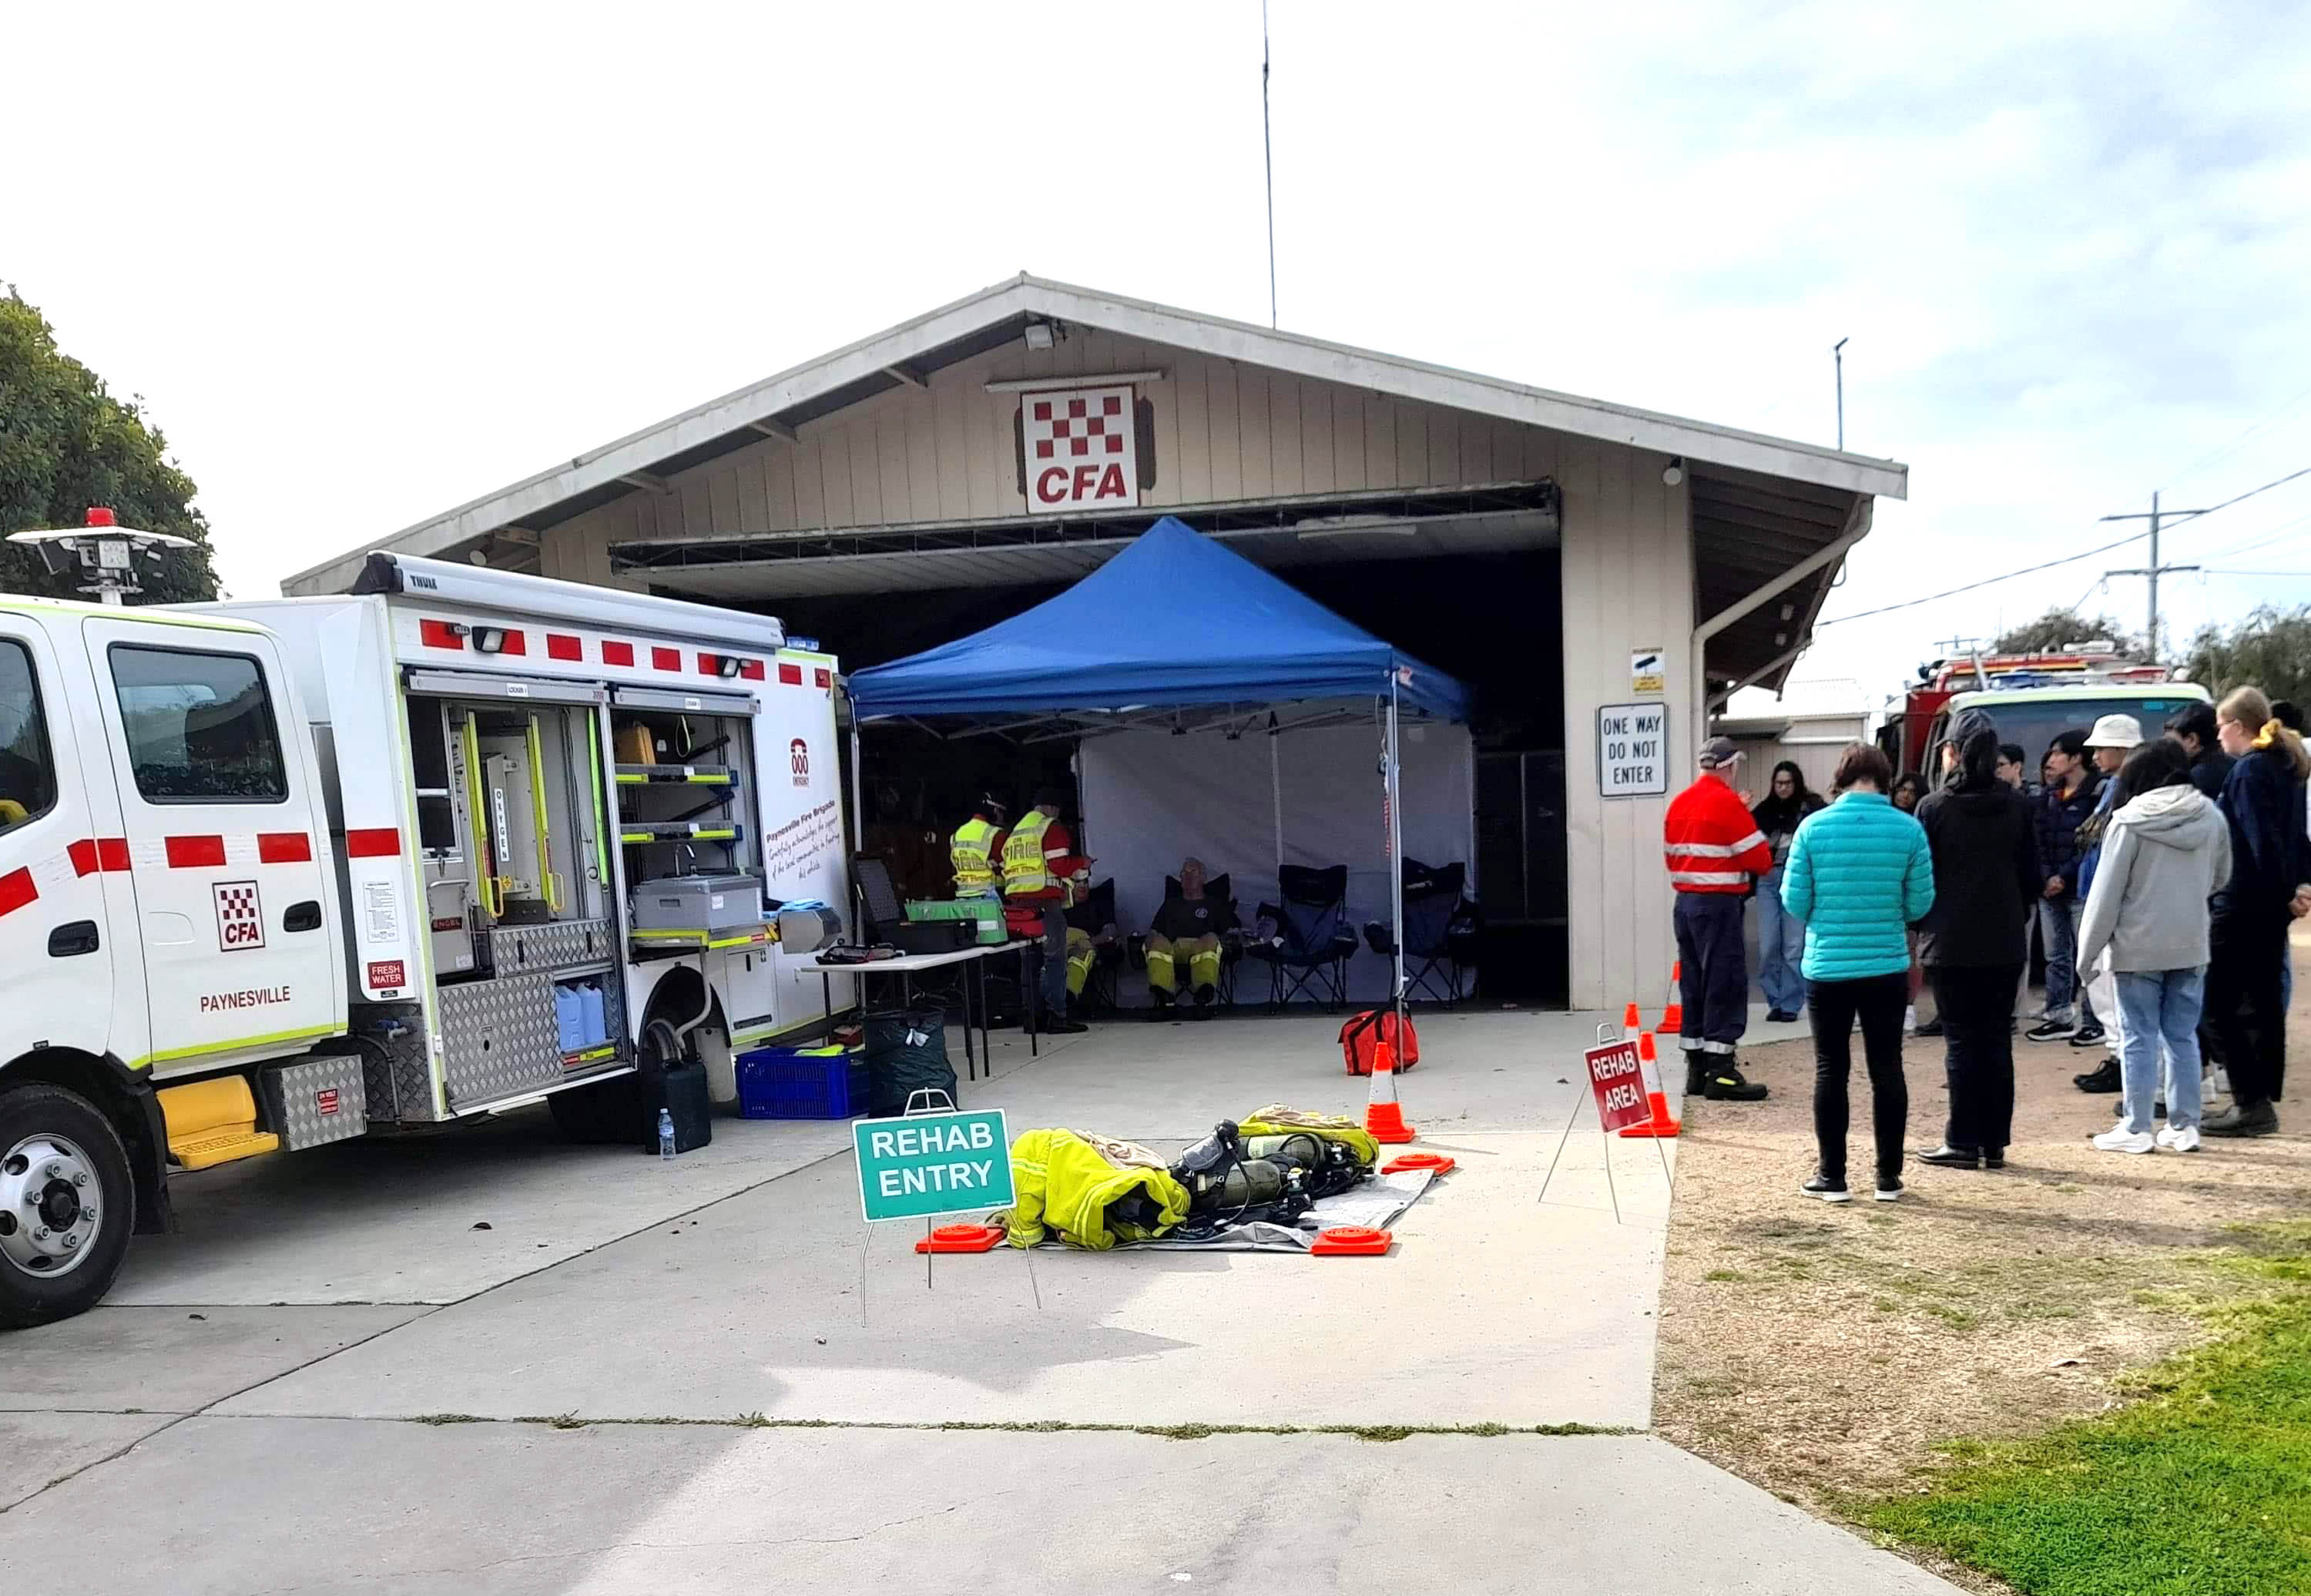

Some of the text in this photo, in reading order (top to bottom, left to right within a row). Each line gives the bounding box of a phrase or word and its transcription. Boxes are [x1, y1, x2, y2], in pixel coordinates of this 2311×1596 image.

[1036, 463, 1126, 503] CFA
[410, 575, 438, 590] THULE
[1604, 716, 1661, 736] ONE WAY
[1609, 741, 1656, 759] DO NOT
[792, 754, 808, 774] 000
[1614, 766, 1652, 784] ENTER
[496, 790, 508, 859] OXYGEN
[766, 800, 835, 843] Paynesville Fire Brigade
[226, 922, 259, 944] CFA
[372, 965, 400, 975] FRESH
[372, 974, 401, 984] WATER
[201, 986, 290, 1012] PAYNESVILLE
[1592, 1051, 1635, 1081] REHAB
[1605, 1082, 1640, 1113] AREA
[870, 1122, 993, 1158] REHAB
[879, 1160, 992, 1197] ENTRY
